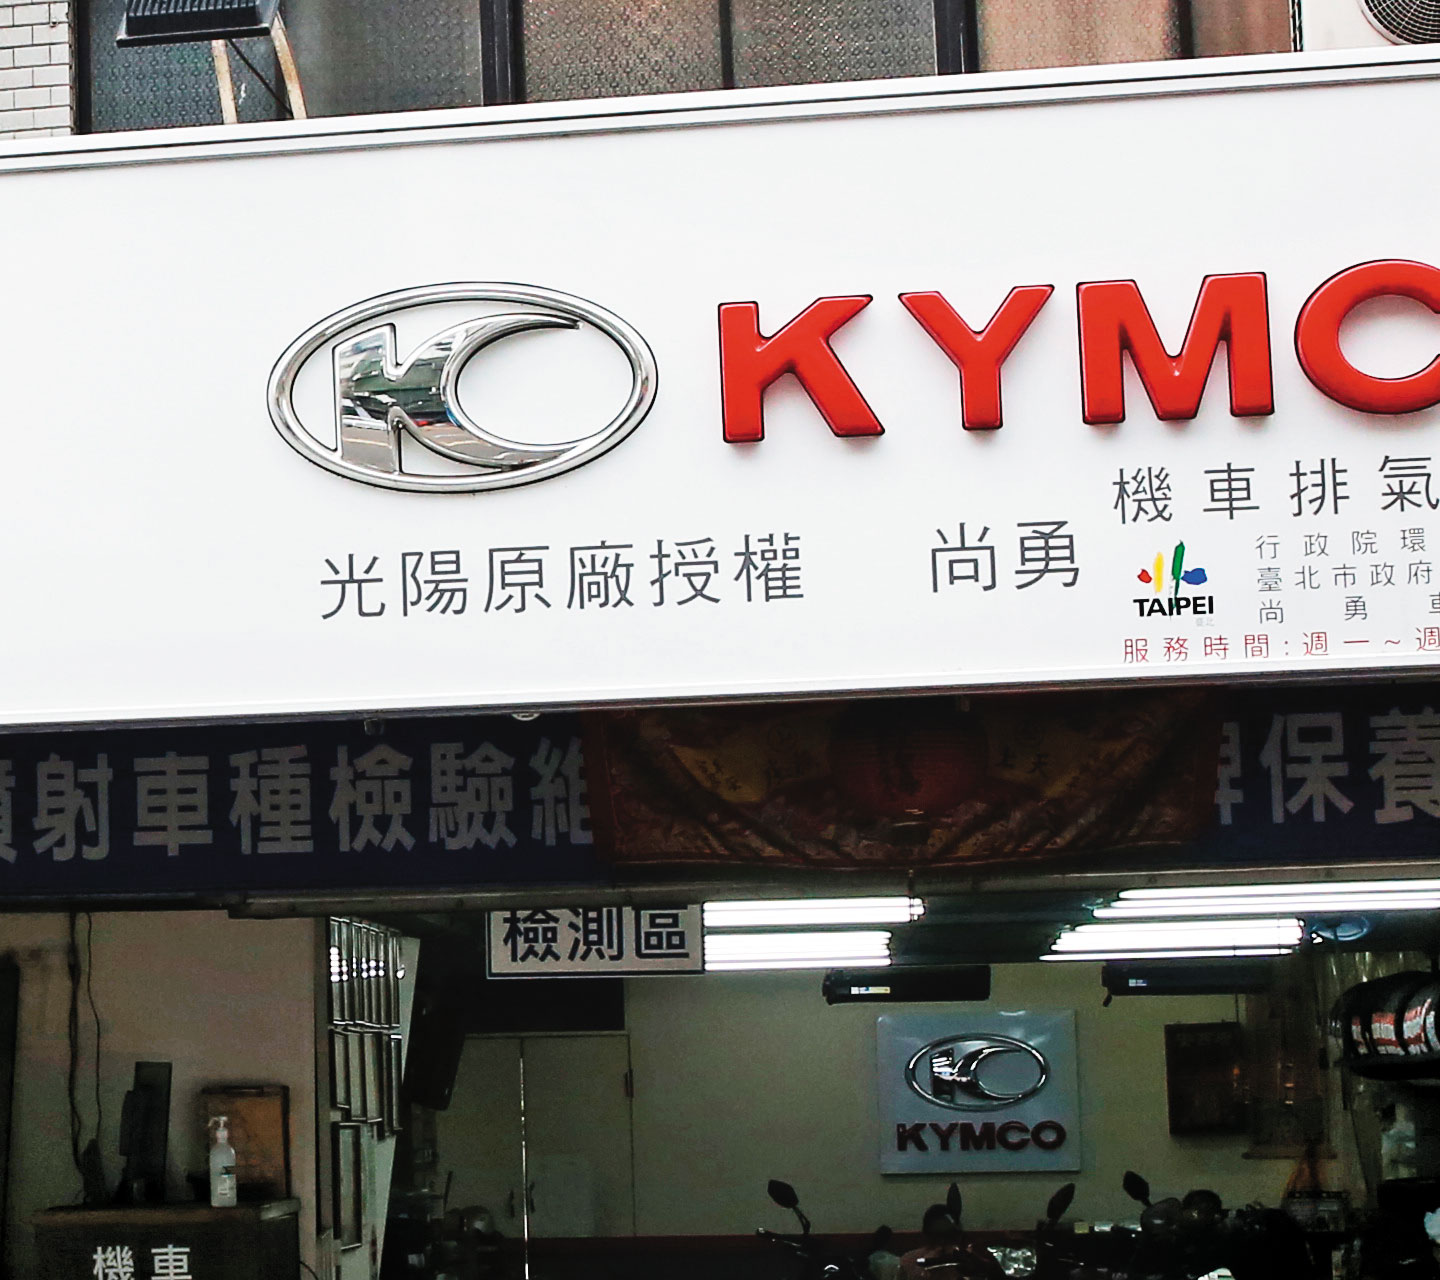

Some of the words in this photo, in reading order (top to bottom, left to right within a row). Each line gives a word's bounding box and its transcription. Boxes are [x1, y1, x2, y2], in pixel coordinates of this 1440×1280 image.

[317, 533, 806, 623] 光陽原廠授權
[927, 520, 1083, 598] 尚勇
[1133, 596, 1214, 617] TAIPEI
[503, 906, 692, 966] 檢測區
[897, 1120, 1066, 1152] KYMCO
